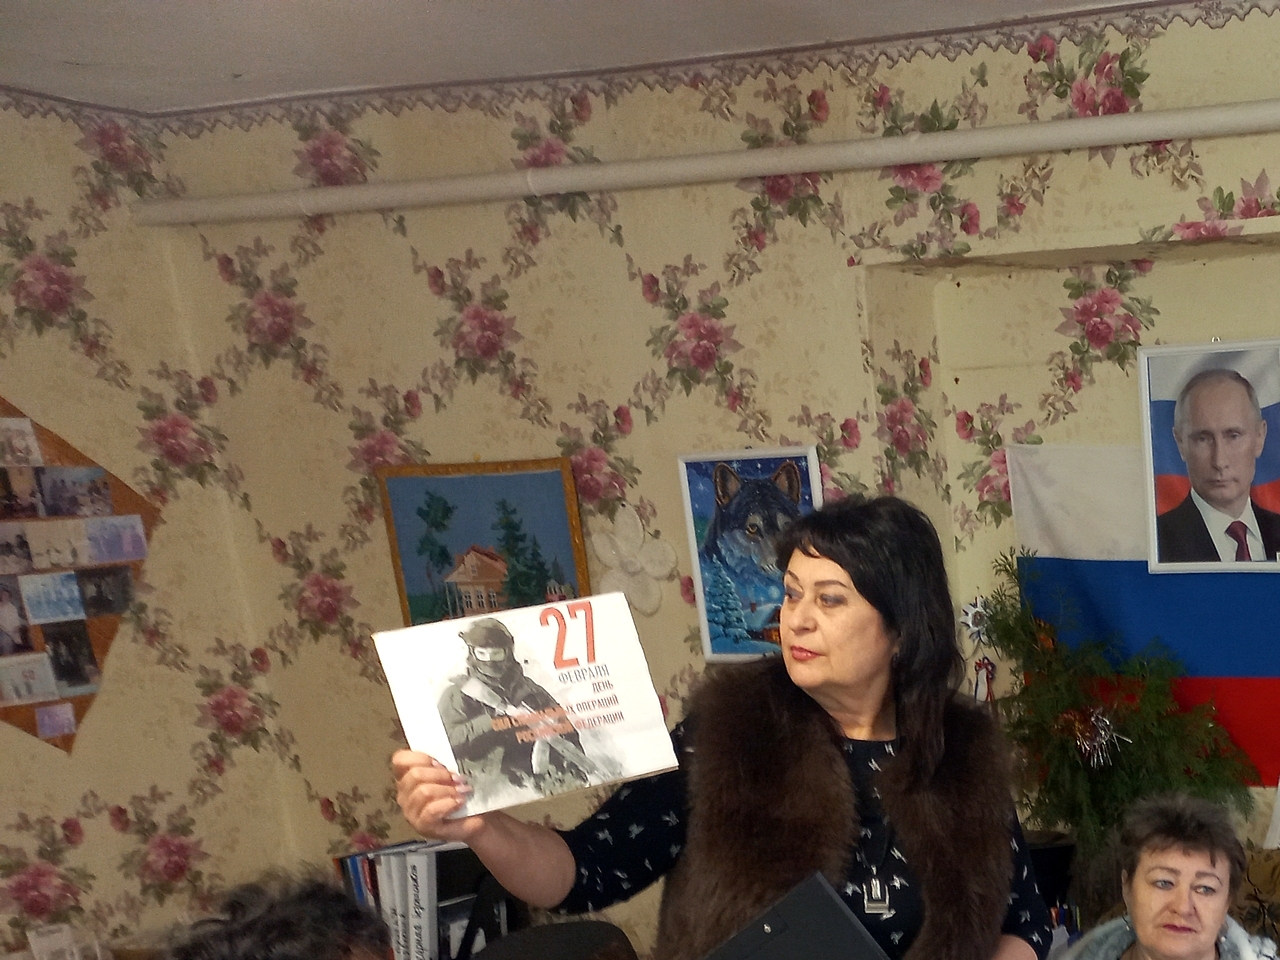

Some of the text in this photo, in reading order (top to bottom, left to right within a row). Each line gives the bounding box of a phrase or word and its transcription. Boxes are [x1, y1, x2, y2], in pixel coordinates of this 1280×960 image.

[539, 600, 596, 670] 27
[558, 664, 610, 684] ФЕВРАЛЯ
[592, 680, 614, 694] ДЕНЬ
[576, 694, 620, 713] ОПЕРАЦИЙ
